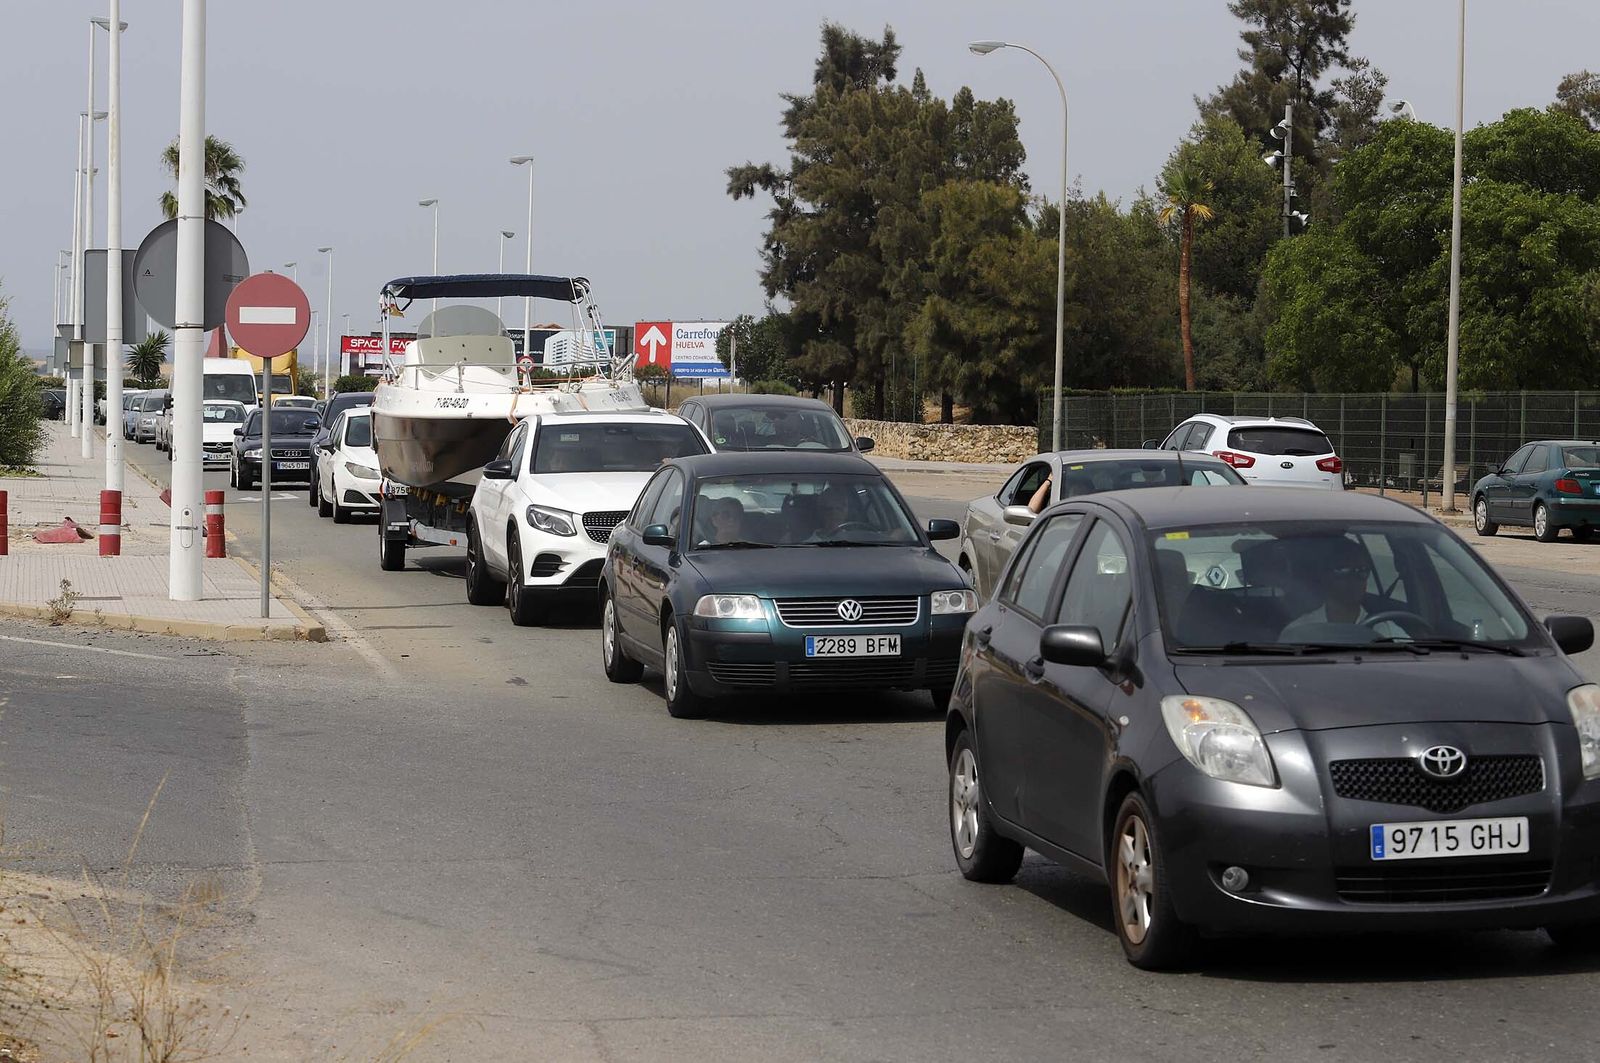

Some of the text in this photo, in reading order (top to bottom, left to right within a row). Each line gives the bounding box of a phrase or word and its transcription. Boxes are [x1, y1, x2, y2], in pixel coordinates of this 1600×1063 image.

[676, 328, 719, 339] Carrefou
[816, 638, 898, 654] 2289 BFM
[1392, 822, 1521, 854] 9715 GHJ
